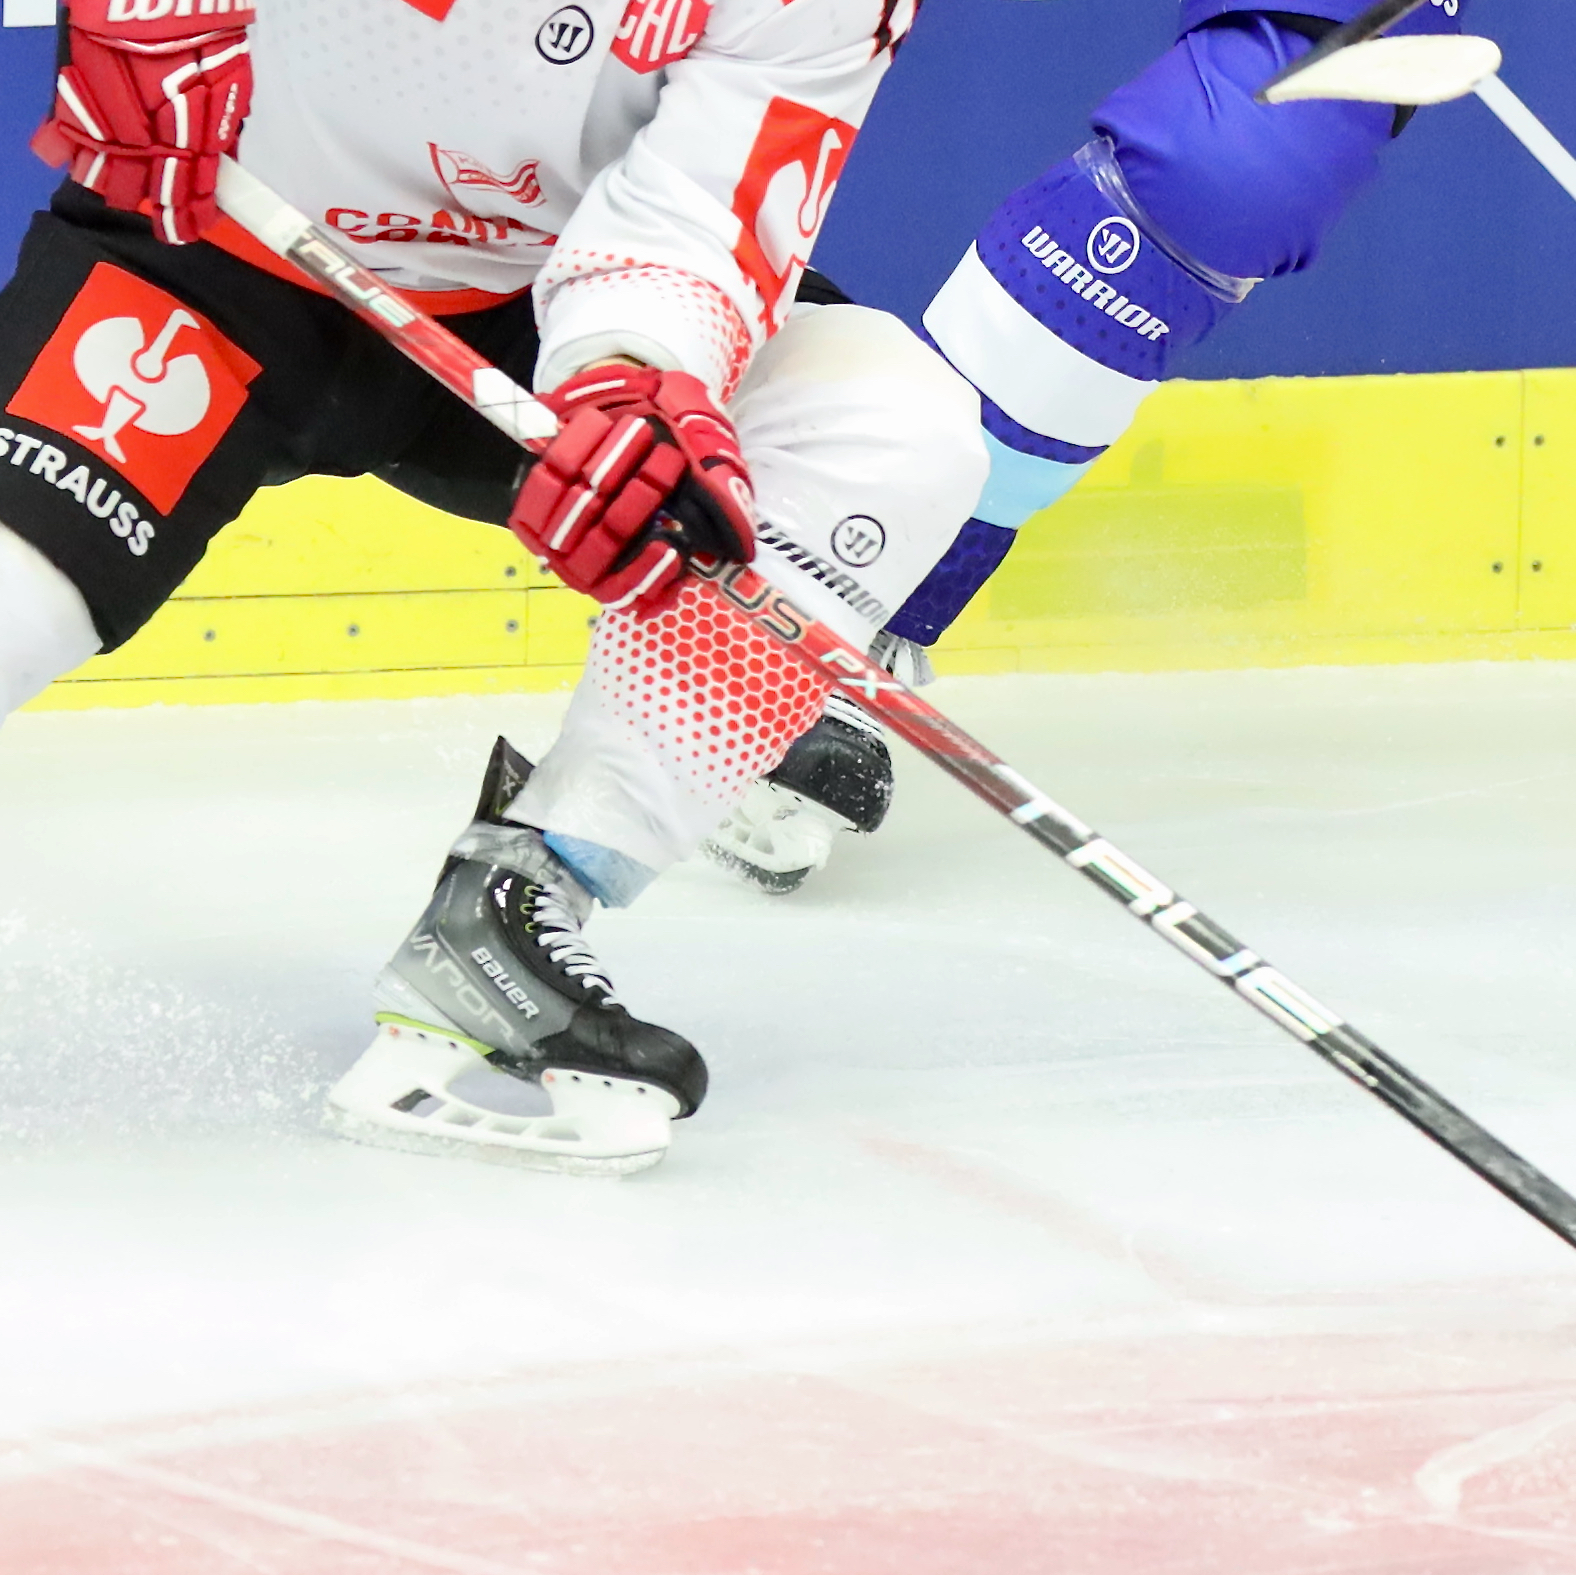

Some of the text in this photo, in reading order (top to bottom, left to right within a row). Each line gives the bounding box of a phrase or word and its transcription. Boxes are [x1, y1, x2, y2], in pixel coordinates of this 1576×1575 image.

[1021, 225, 1170, 341] WARRIOR
[994, 762, 1348, 1041] TRUE
[471, 946, 540, 1020] BAUER
